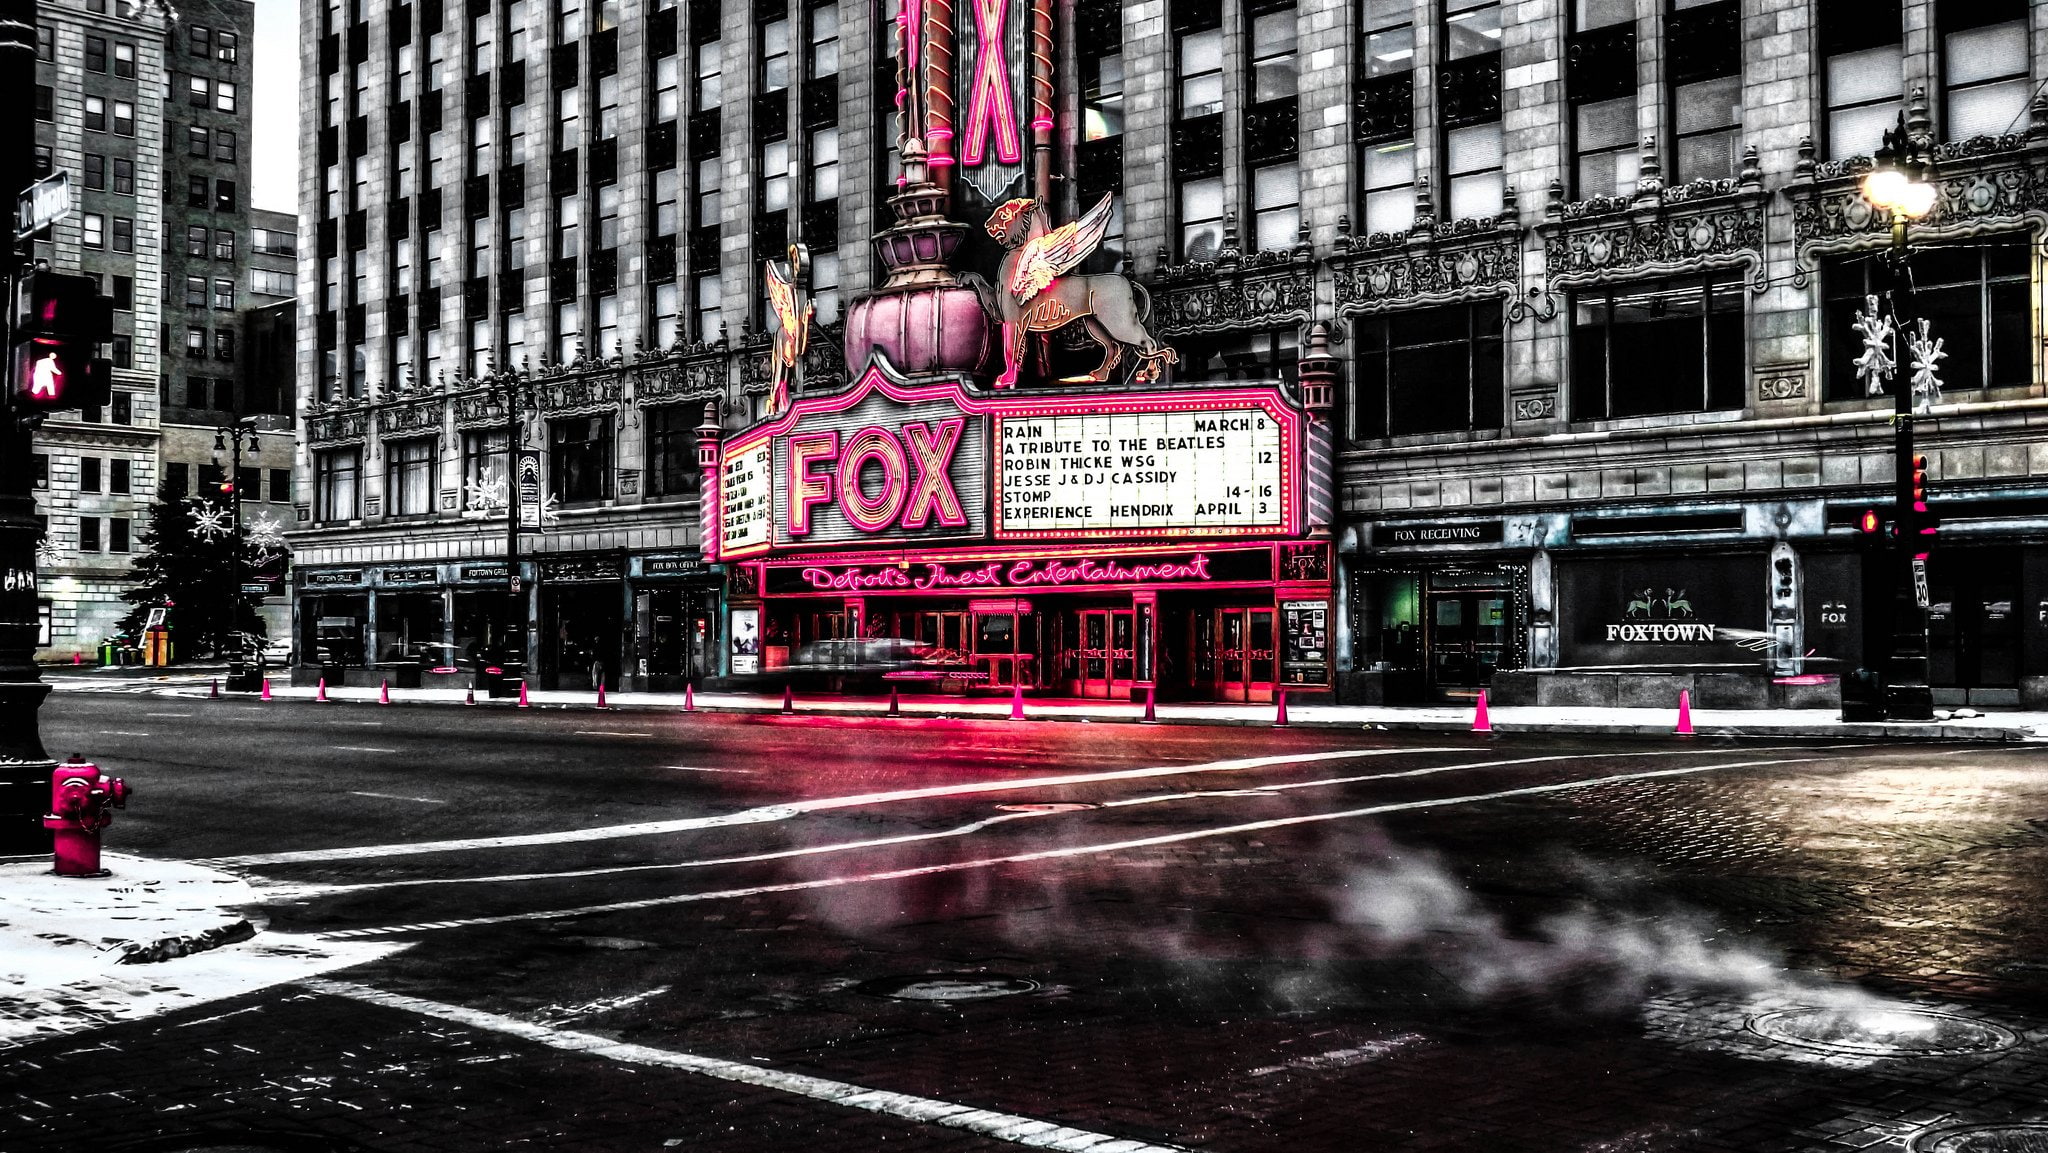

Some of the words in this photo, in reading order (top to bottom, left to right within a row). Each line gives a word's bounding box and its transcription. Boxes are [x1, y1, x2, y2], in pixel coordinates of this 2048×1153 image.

[1004, 425, 1042, 438] RAIN
[1195, 419, 1249, 432] MARCH
[1257, 418, 1265, 430] 8
[1004, 443, 1014, 454] A
[1019, 441, 1082, 454] TRIBUTE
[1092, 439, 1110, 452] TO
[1119, 438, 1147, 451] THE
[1157, 436, 1225, 450] BEATLES
[1005, 458, 1050, 471] ROBIN
[1061, 456, 1112, 469] THICKE
[1121, 455, 1155, 468] WSG
[1258, 451, 1272, 464] 12
[788, 417, 967, 536] FOX
[1004, 474, 1050, 487] JESSE
[1058, 474, 1066, 485] J
[1071, 474, 1078, 485] &
[1084, 473, 1104, 485] DJ
[1111, 471, 1177, 484] CASSIDY
[1004, 490, 1051, 503] STOMP
[1004, 506, 1093, 519] EXPERIENCE
[1110, 504, 1173, 517] HENDRIX
[1195, 502, 1242, 515] APRIL
[1259, 502, 1267, 514] 3
[1395, 529, 1416, 541] FOX
[1420, 527, 1480, 540] RECEIVING
[802, 567, 911, 590] Detroit's
[914, 563, 1002, 590] Finest
[1008, 553, 1212, 585] Entertainment
[1916, 583, 1928, 603] 30
[1821, 612, 1847, 623] FOX
[1605, 624, 1716, 642] FOXTOWN
